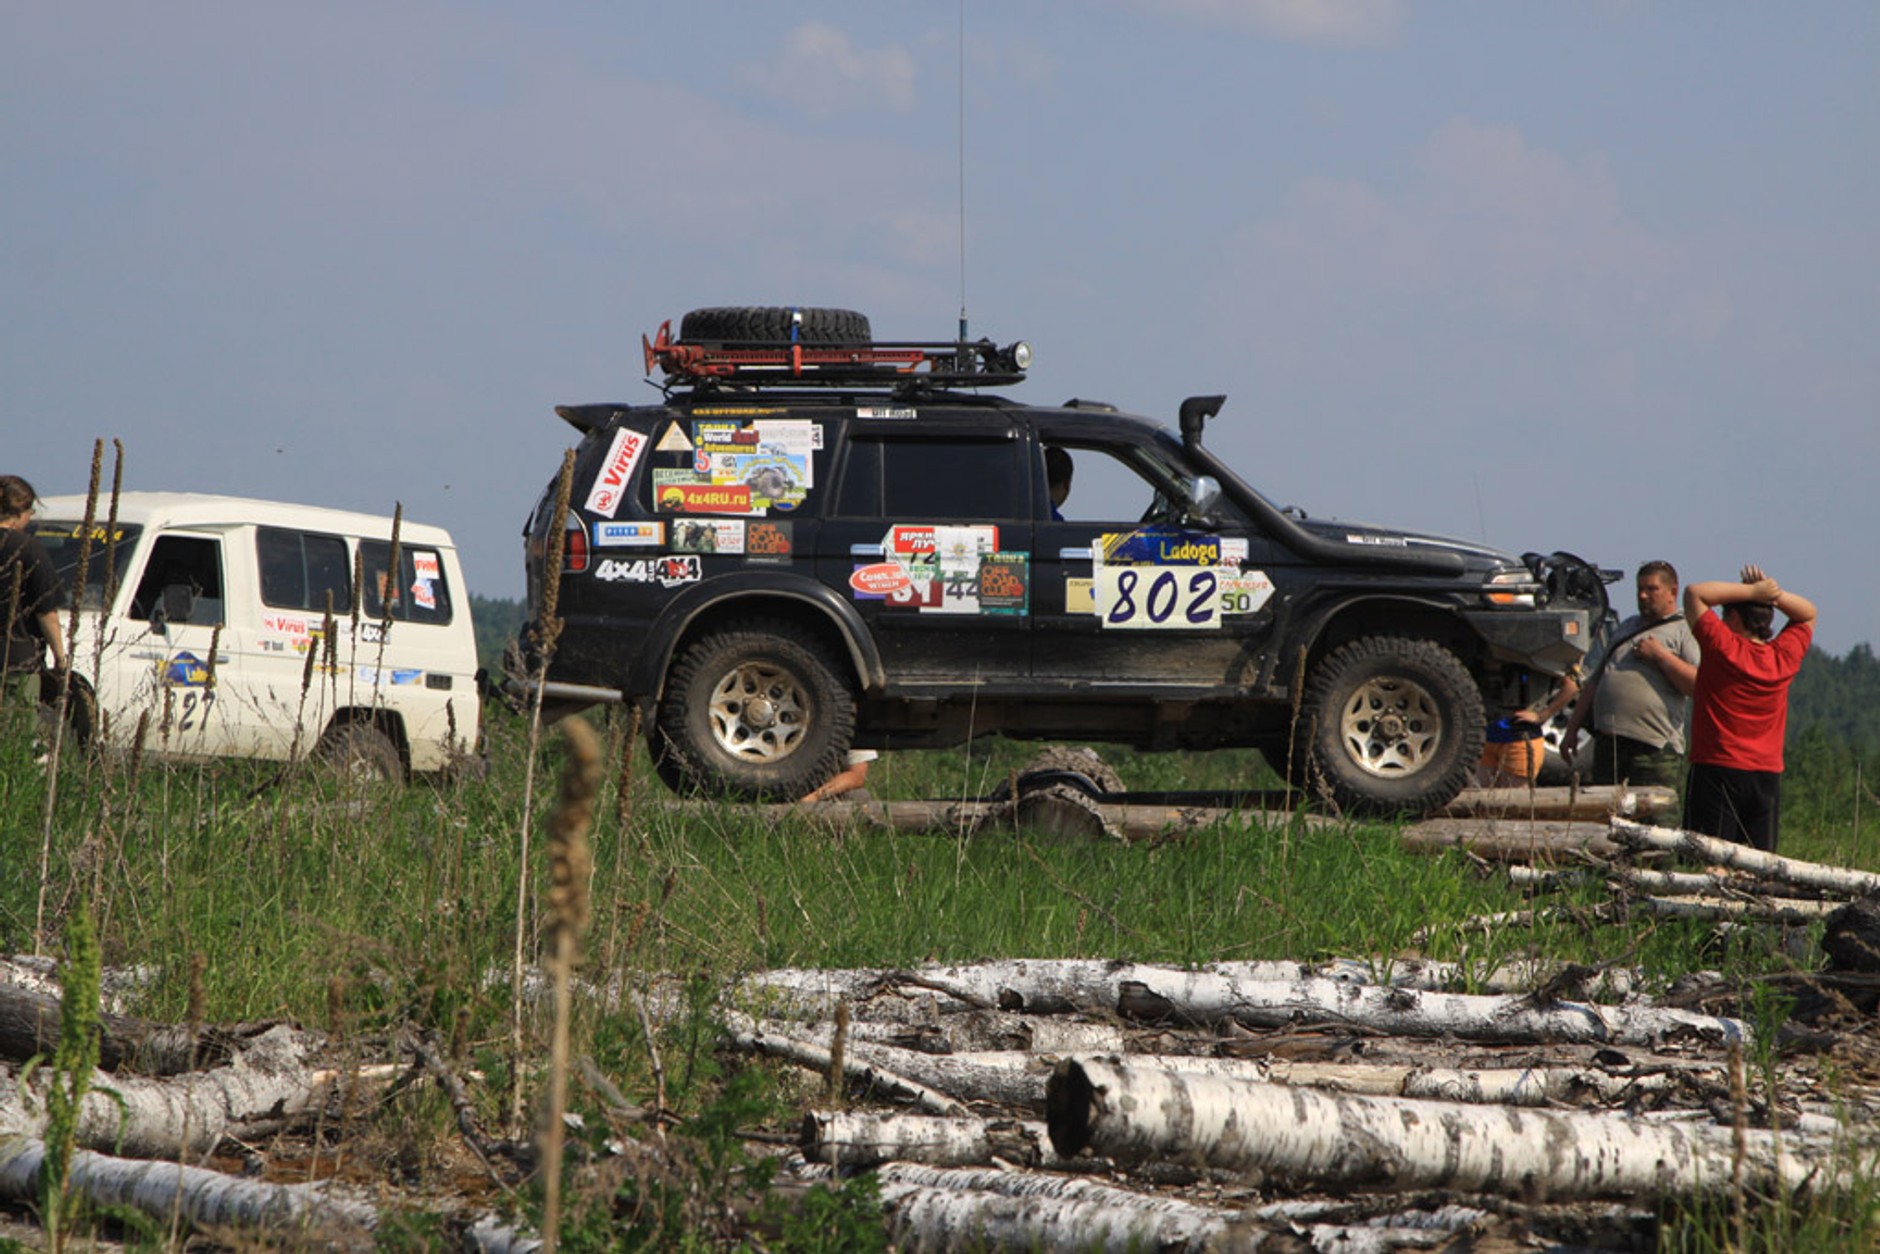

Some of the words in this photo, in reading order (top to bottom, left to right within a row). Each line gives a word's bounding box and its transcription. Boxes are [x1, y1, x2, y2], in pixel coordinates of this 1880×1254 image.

[604, 435, 639, 487] Virus
[695, 448, 711, 472] 5
[687, 492, 747, 505] 4x4RU.ru
[1160, 541, 1218, 565] Ladoga
[1108, 570, 1217, 624] 802
[1221, 593, 1250, 612] 50
[277, 618, 305, 634] Virus
